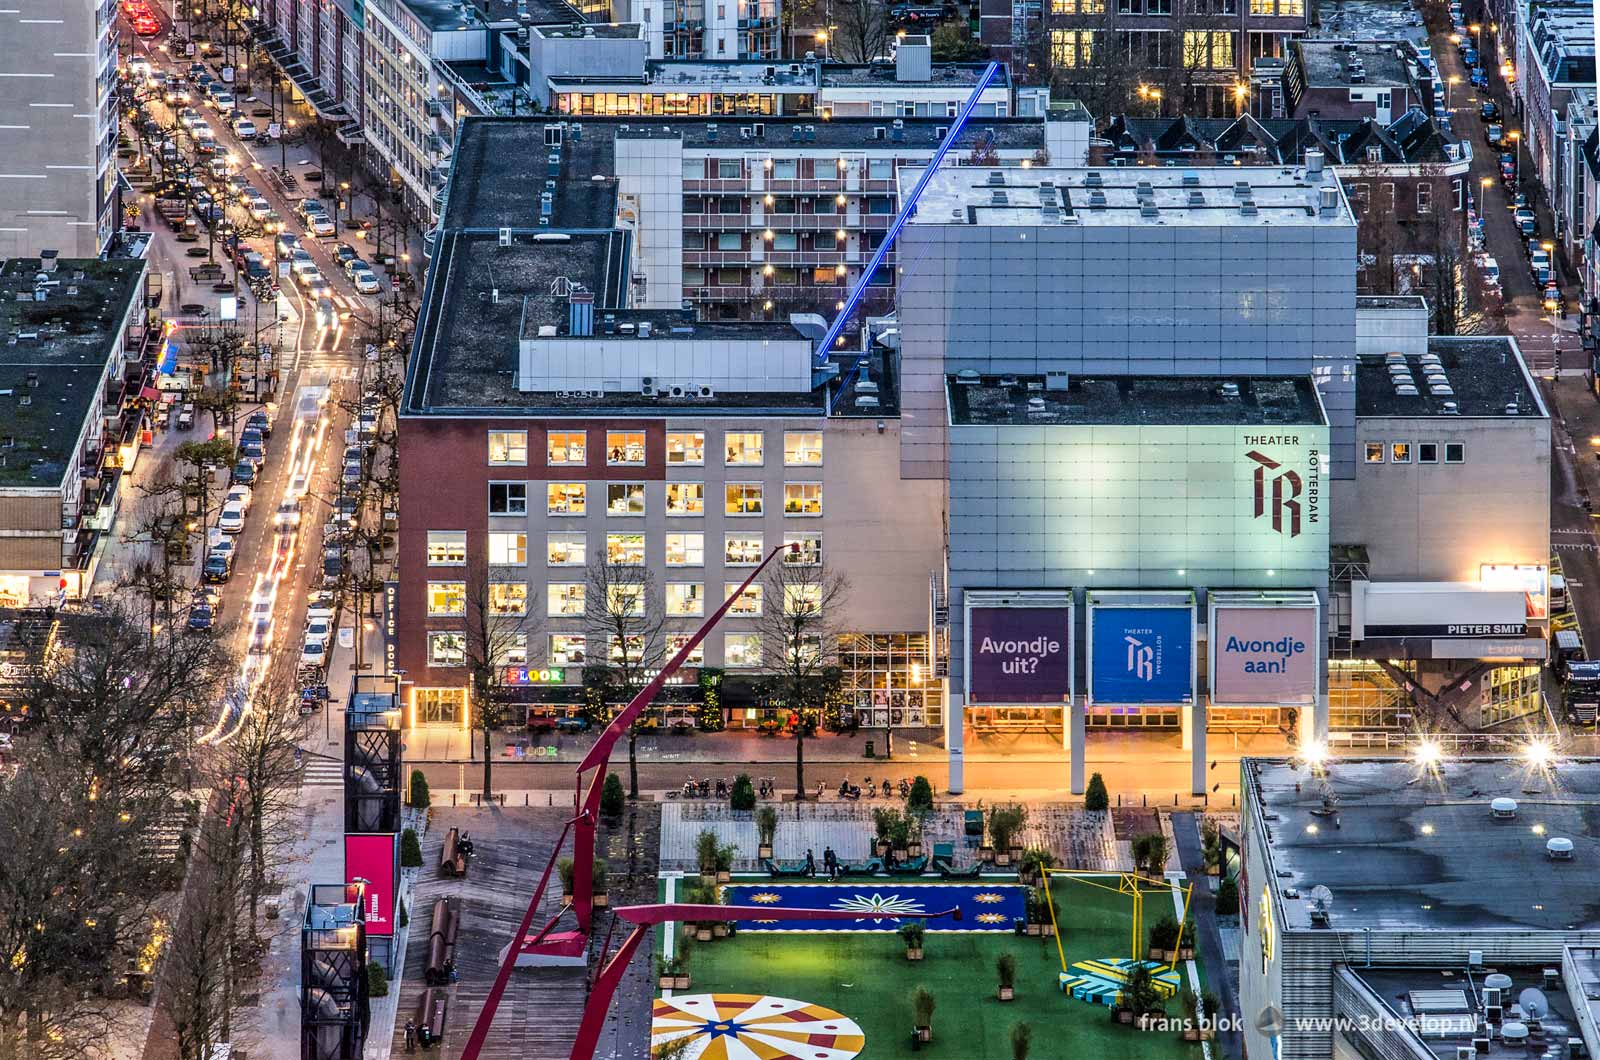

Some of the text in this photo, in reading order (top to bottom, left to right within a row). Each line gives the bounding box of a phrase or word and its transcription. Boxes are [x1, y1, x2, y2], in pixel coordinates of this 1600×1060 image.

[1244, 436, 1299, 445] THEATER
[1308, 449, 1319, 523] ROTTERDAM
[387, 587, 396, 636] OFFICE
[1448, 625, 1523, 634] PIETER SMIT
[979, 636, 1060, 658] Avondje
[1225, 636, 1305, 657] Avondje
[1002, 657, 1039, 674] uit?
[1244, 657, 1287, 674] aan!
[508, 669, 562, 682] FLOOR
